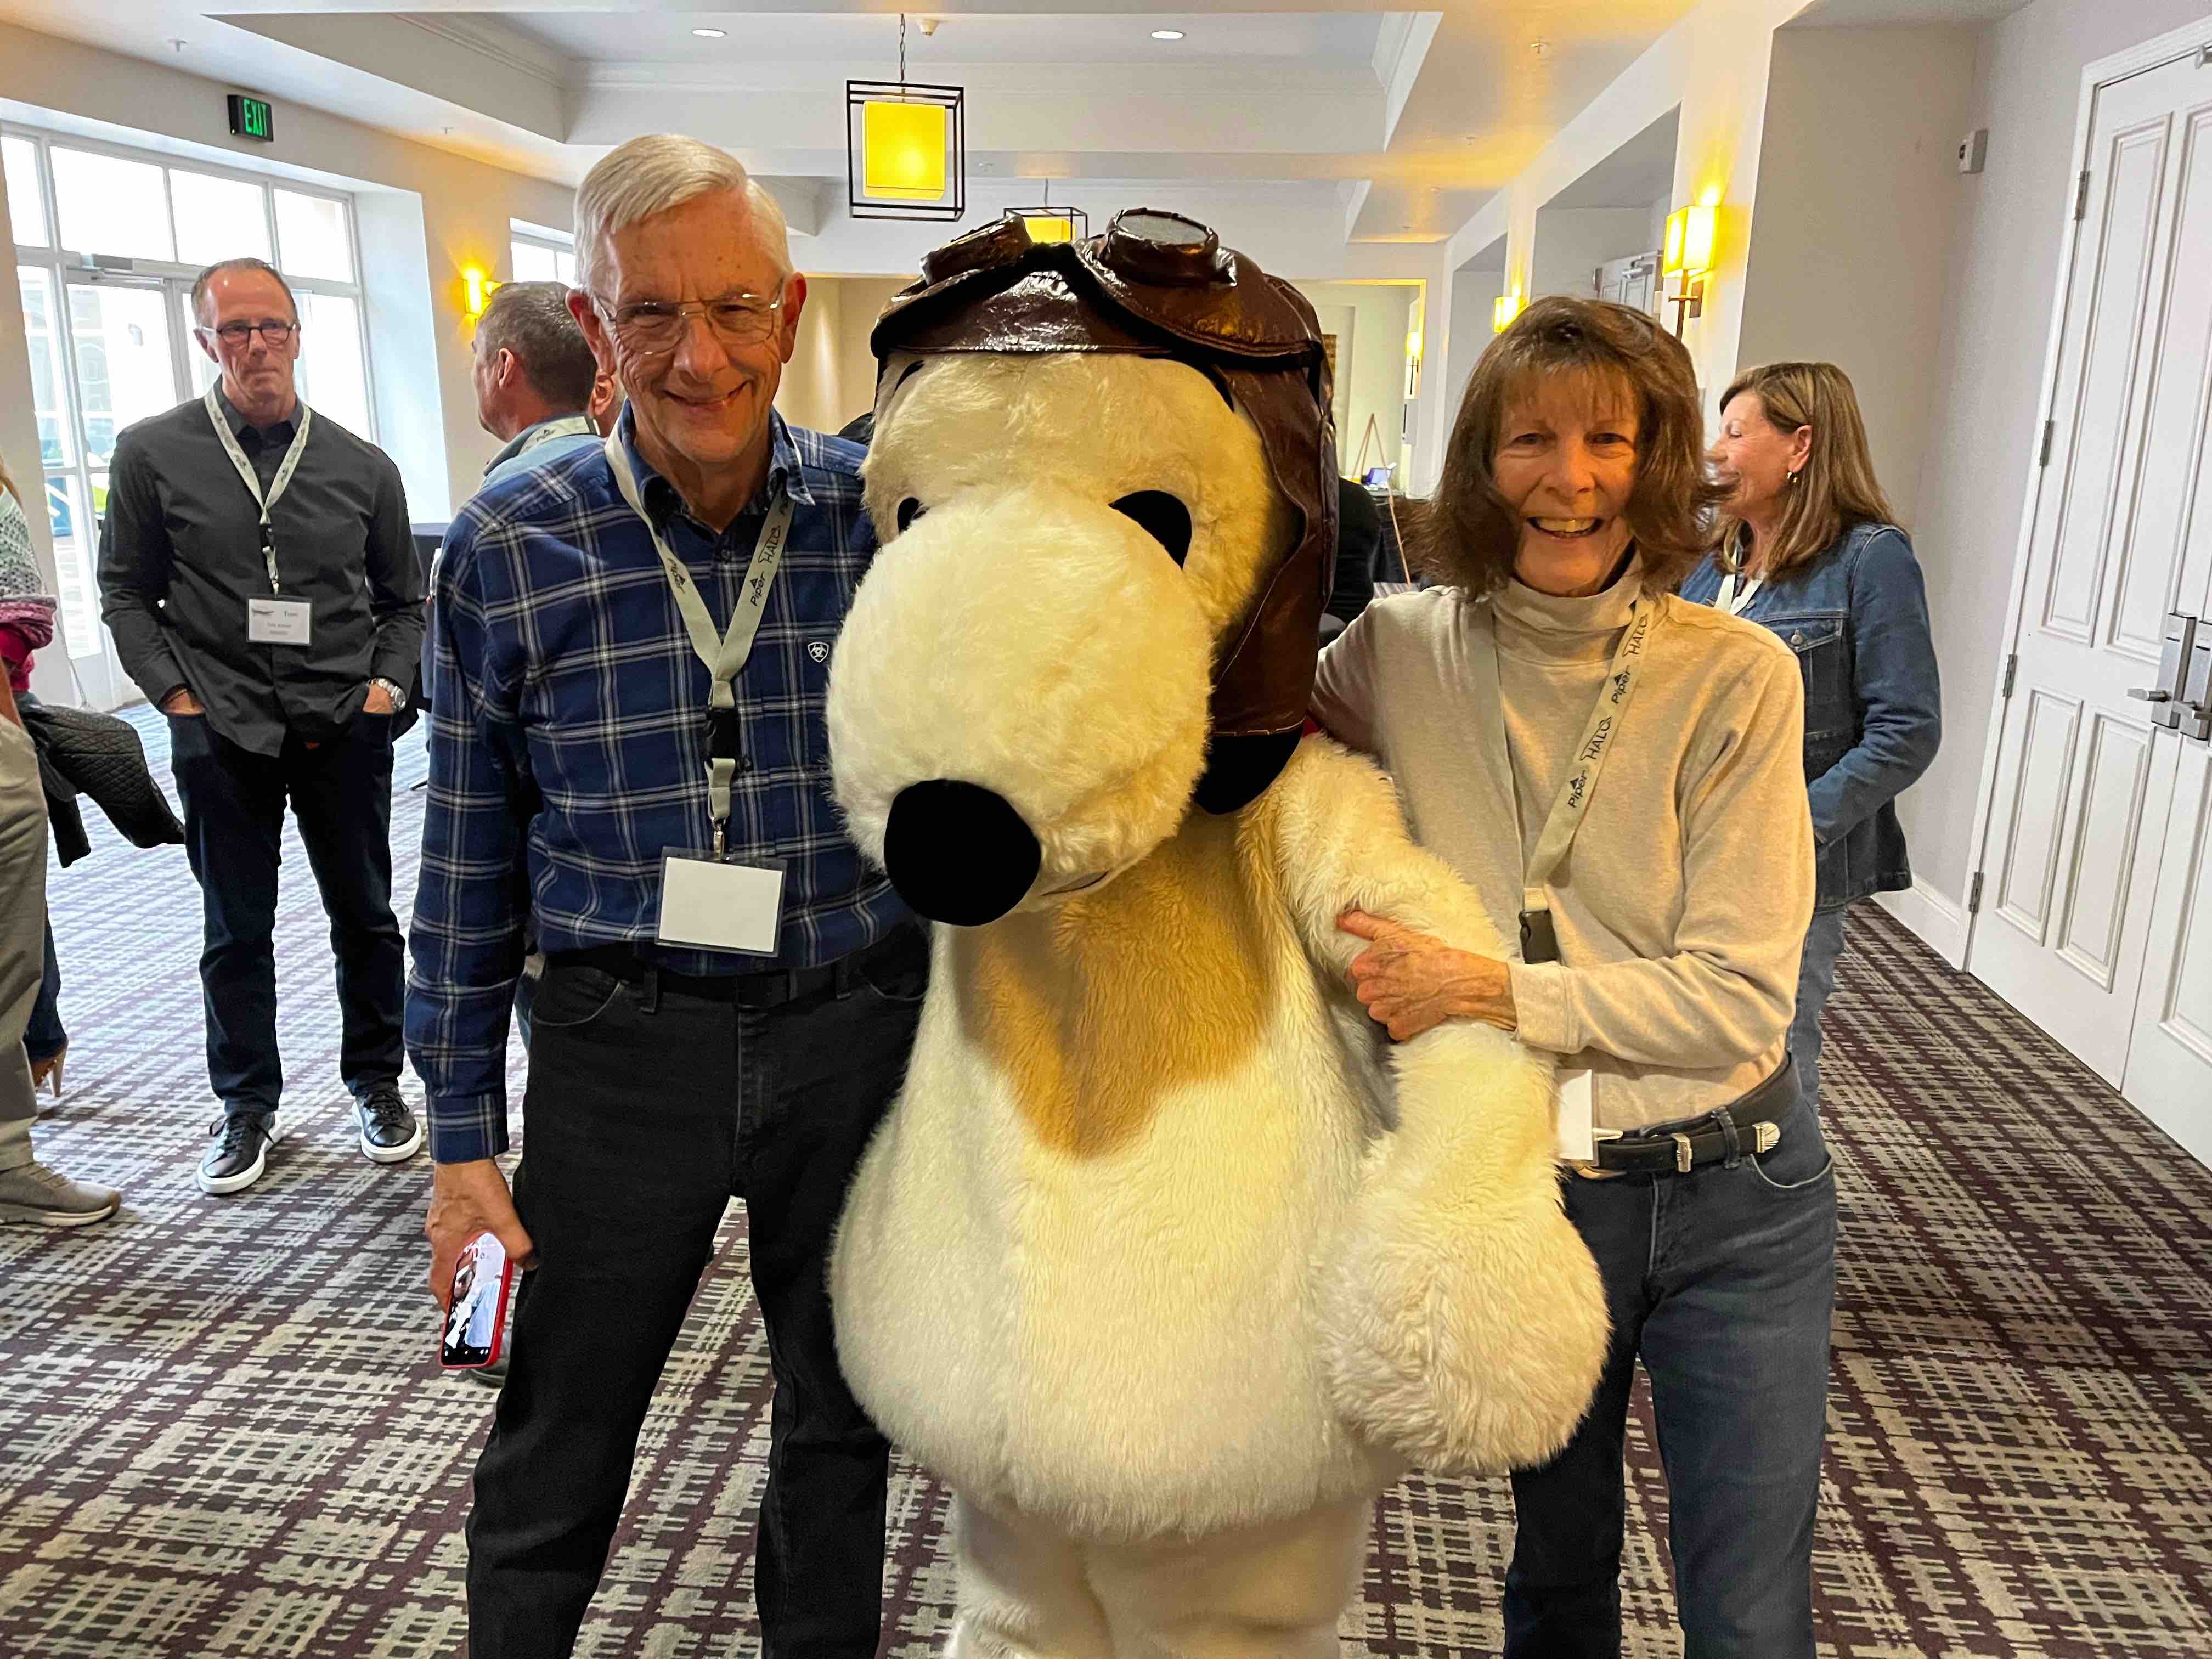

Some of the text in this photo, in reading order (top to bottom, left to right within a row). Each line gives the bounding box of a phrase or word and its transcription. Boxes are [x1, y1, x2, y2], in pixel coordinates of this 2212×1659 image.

[244, 99, 267, 136] EXIT
[751, 571, 766, 606] Piper
[1568, 613, 1649, 808] Piper HALO Piper HALO
